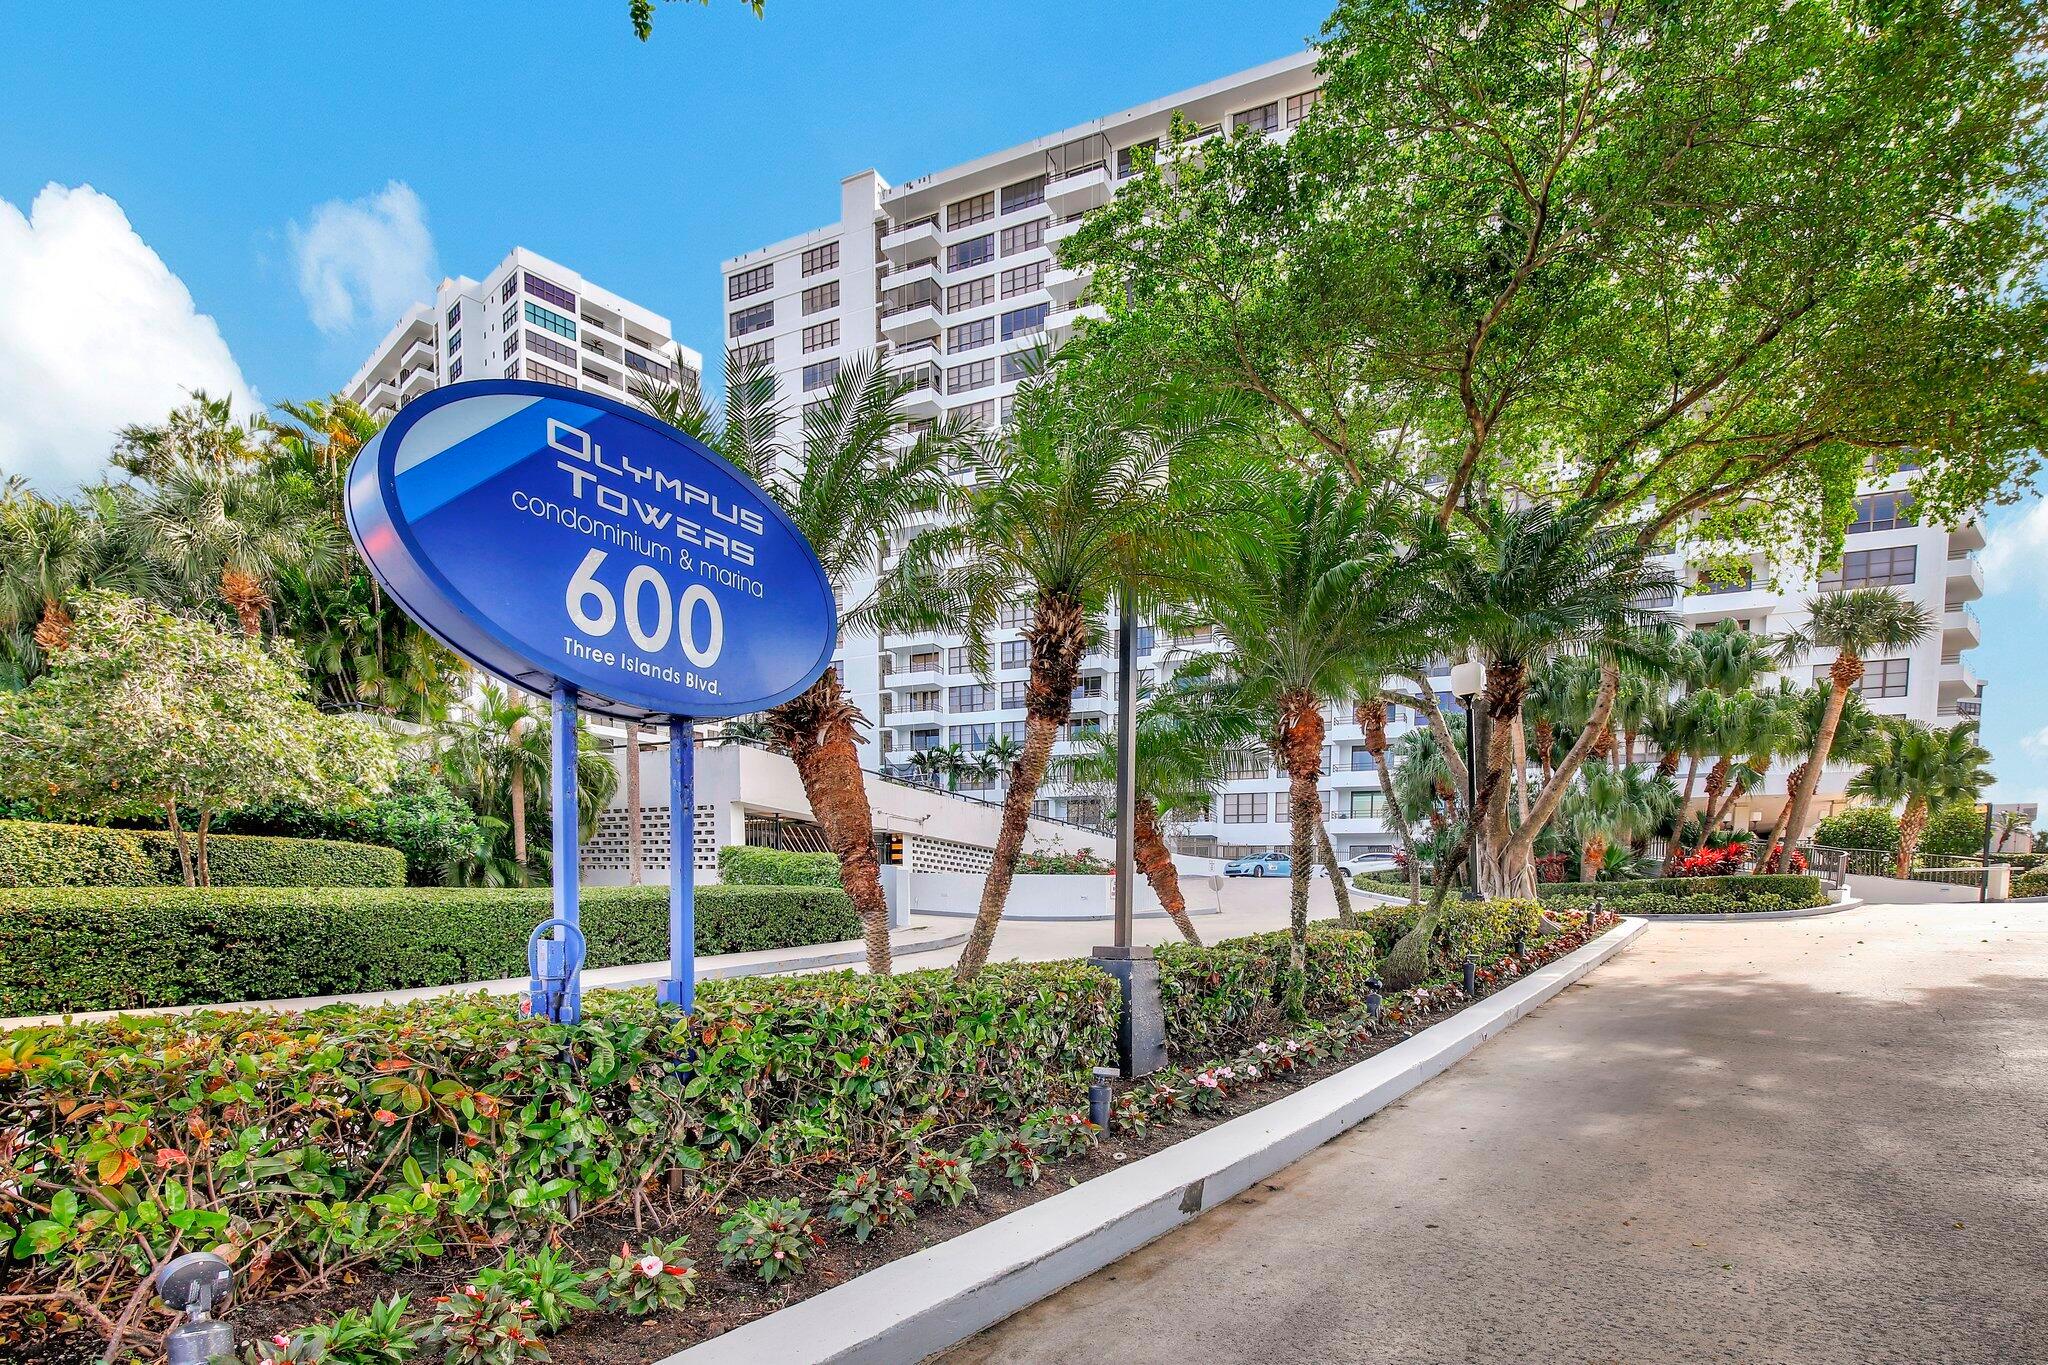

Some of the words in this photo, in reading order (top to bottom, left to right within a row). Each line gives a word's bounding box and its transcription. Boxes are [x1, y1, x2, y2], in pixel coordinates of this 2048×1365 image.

[546, 417, 764, 536] OLYMPUS
[556, 460, 755, 567] TOWERS
[511, 491, 673, 565] condominium
[679, 548, 694, 572] &
[700, 560, 764, 599] marina
[565, 547, 724, 669] 600
[563, 636, 616, 667] Three
[621, 652, 681, 686] Islands
[685, 671, 723, 696] Blvd.
